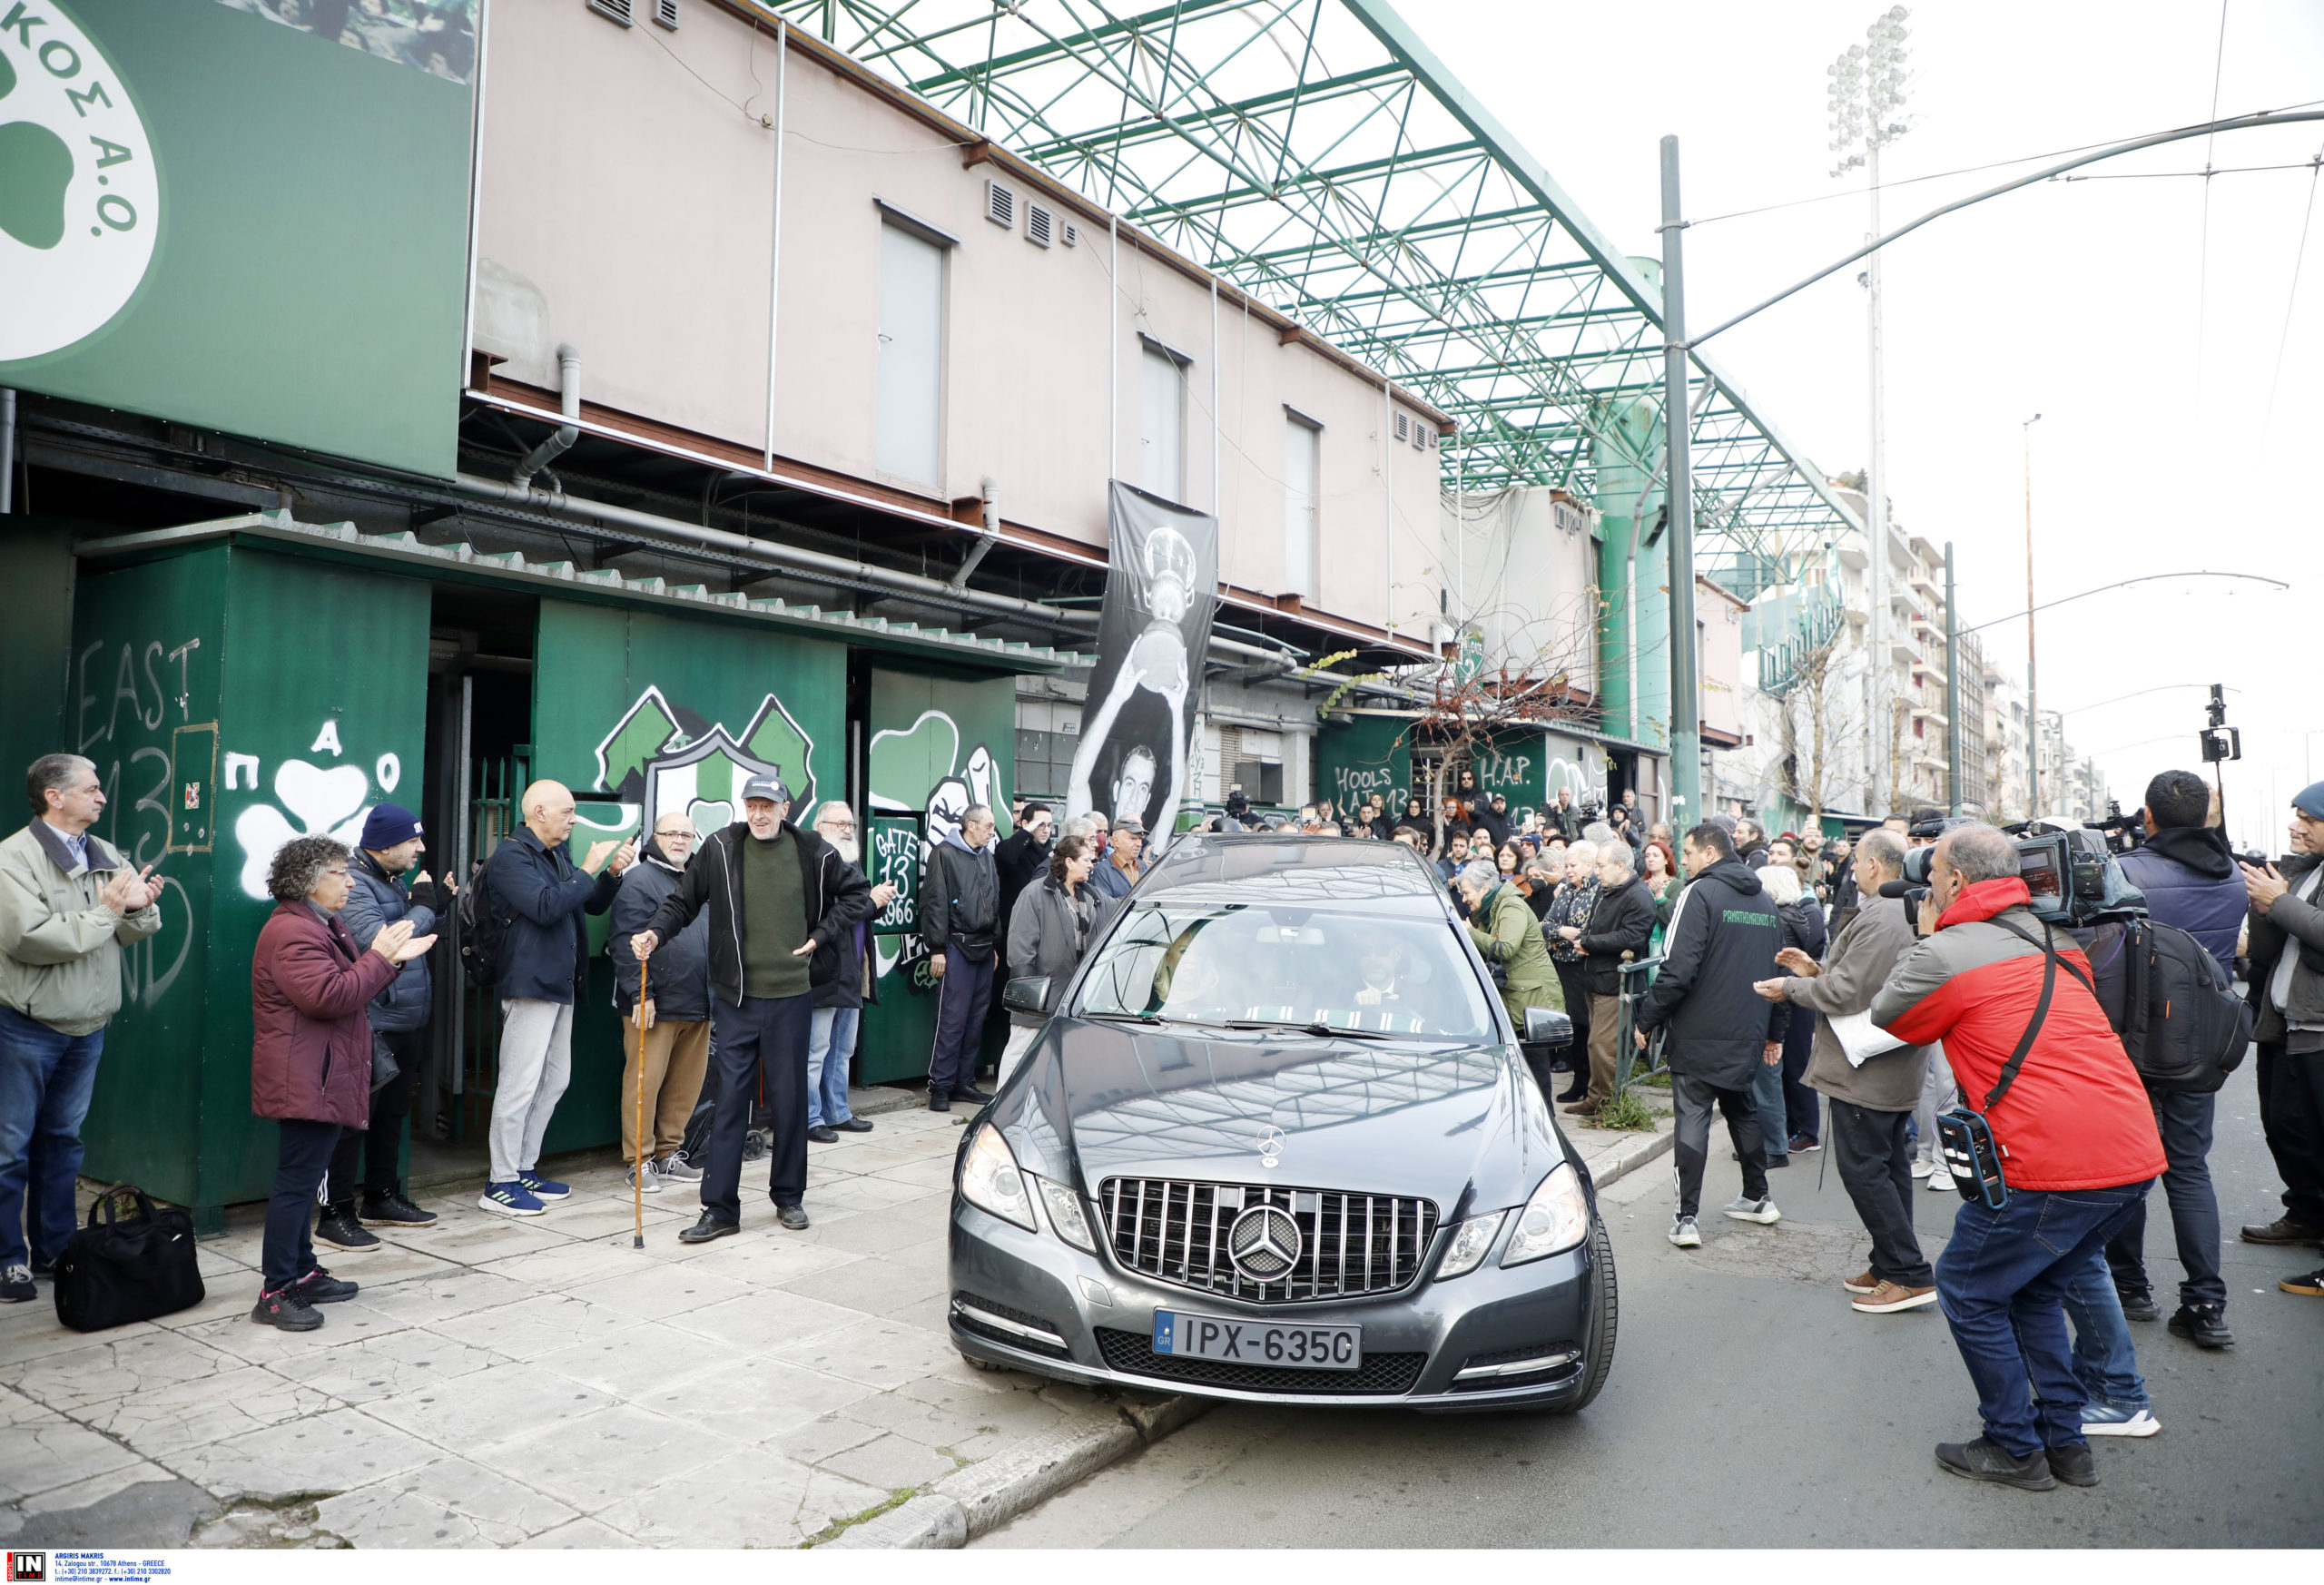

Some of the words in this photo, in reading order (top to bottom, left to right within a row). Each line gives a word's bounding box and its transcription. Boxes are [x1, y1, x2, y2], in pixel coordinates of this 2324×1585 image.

[79, 638, 200, 753] EAST
[1334, 767, 1392, 792] HOOLS
[103, 747, 172, 871] 13
[875, 828, 920, 860] GATE
[880, 855, 910, 899] 13
[874, 899, 914, 927] 966
[1723, 910, 1769, 927] PANATHINAIKOS
[1769, 915, 1777, 928] FC
[1157, 1335, 1171, 1345] GR
[1186, 1319, 1353, 1363] IPX-6350
